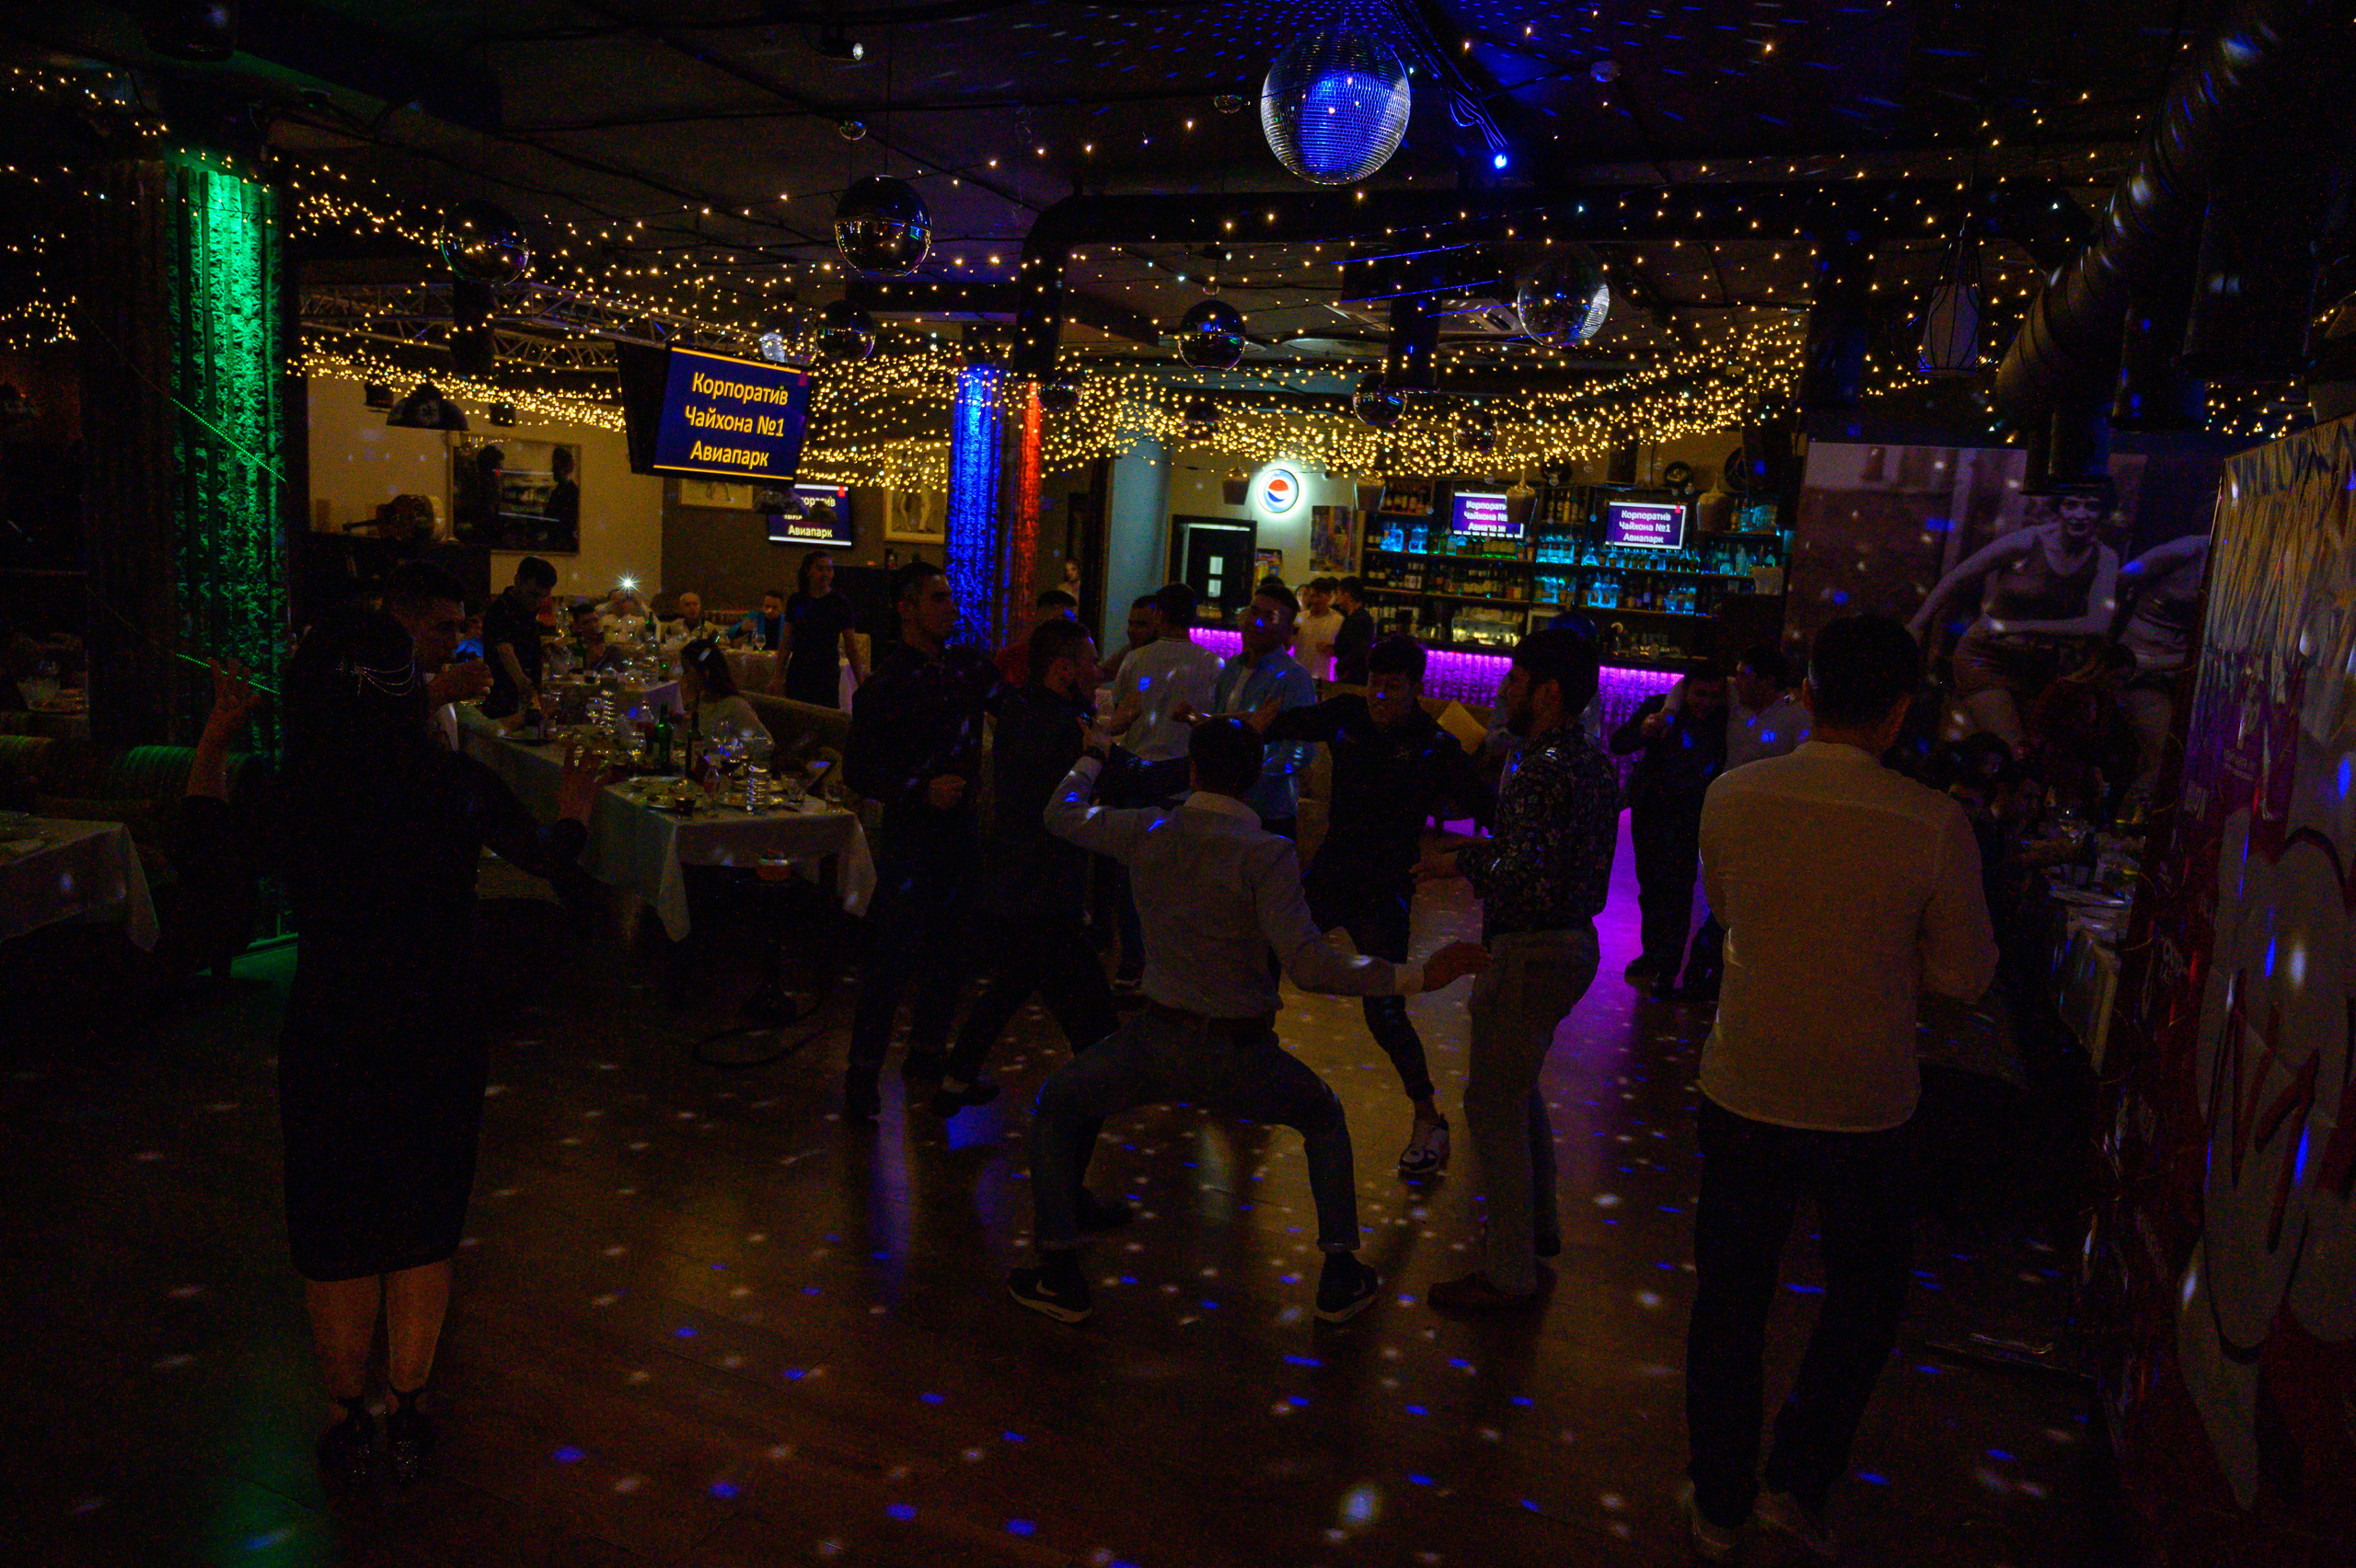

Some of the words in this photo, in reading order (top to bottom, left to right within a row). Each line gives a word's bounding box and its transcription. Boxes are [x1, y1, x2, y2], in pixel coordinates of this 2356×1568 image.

[691, 372, 789, 406] Корпоратив
[685, 405, 754, 433] Чайхона
[756, 415, 785, 437] №1
[689, 440, 769, 470] Авиапарк
[1465, 500, 1507, 512] Корпорат
[1463, 511, 1497, 521] Чайхона
[1621, 510, 1671, 522] Корпоратив
[787, 524, 833, 540] Авиапарк
[1619, 521, 1654, 532] Чайхона
[1655, 523, 1671, 533] №1
[1623, 532, 1664, 545] Авиапарк
